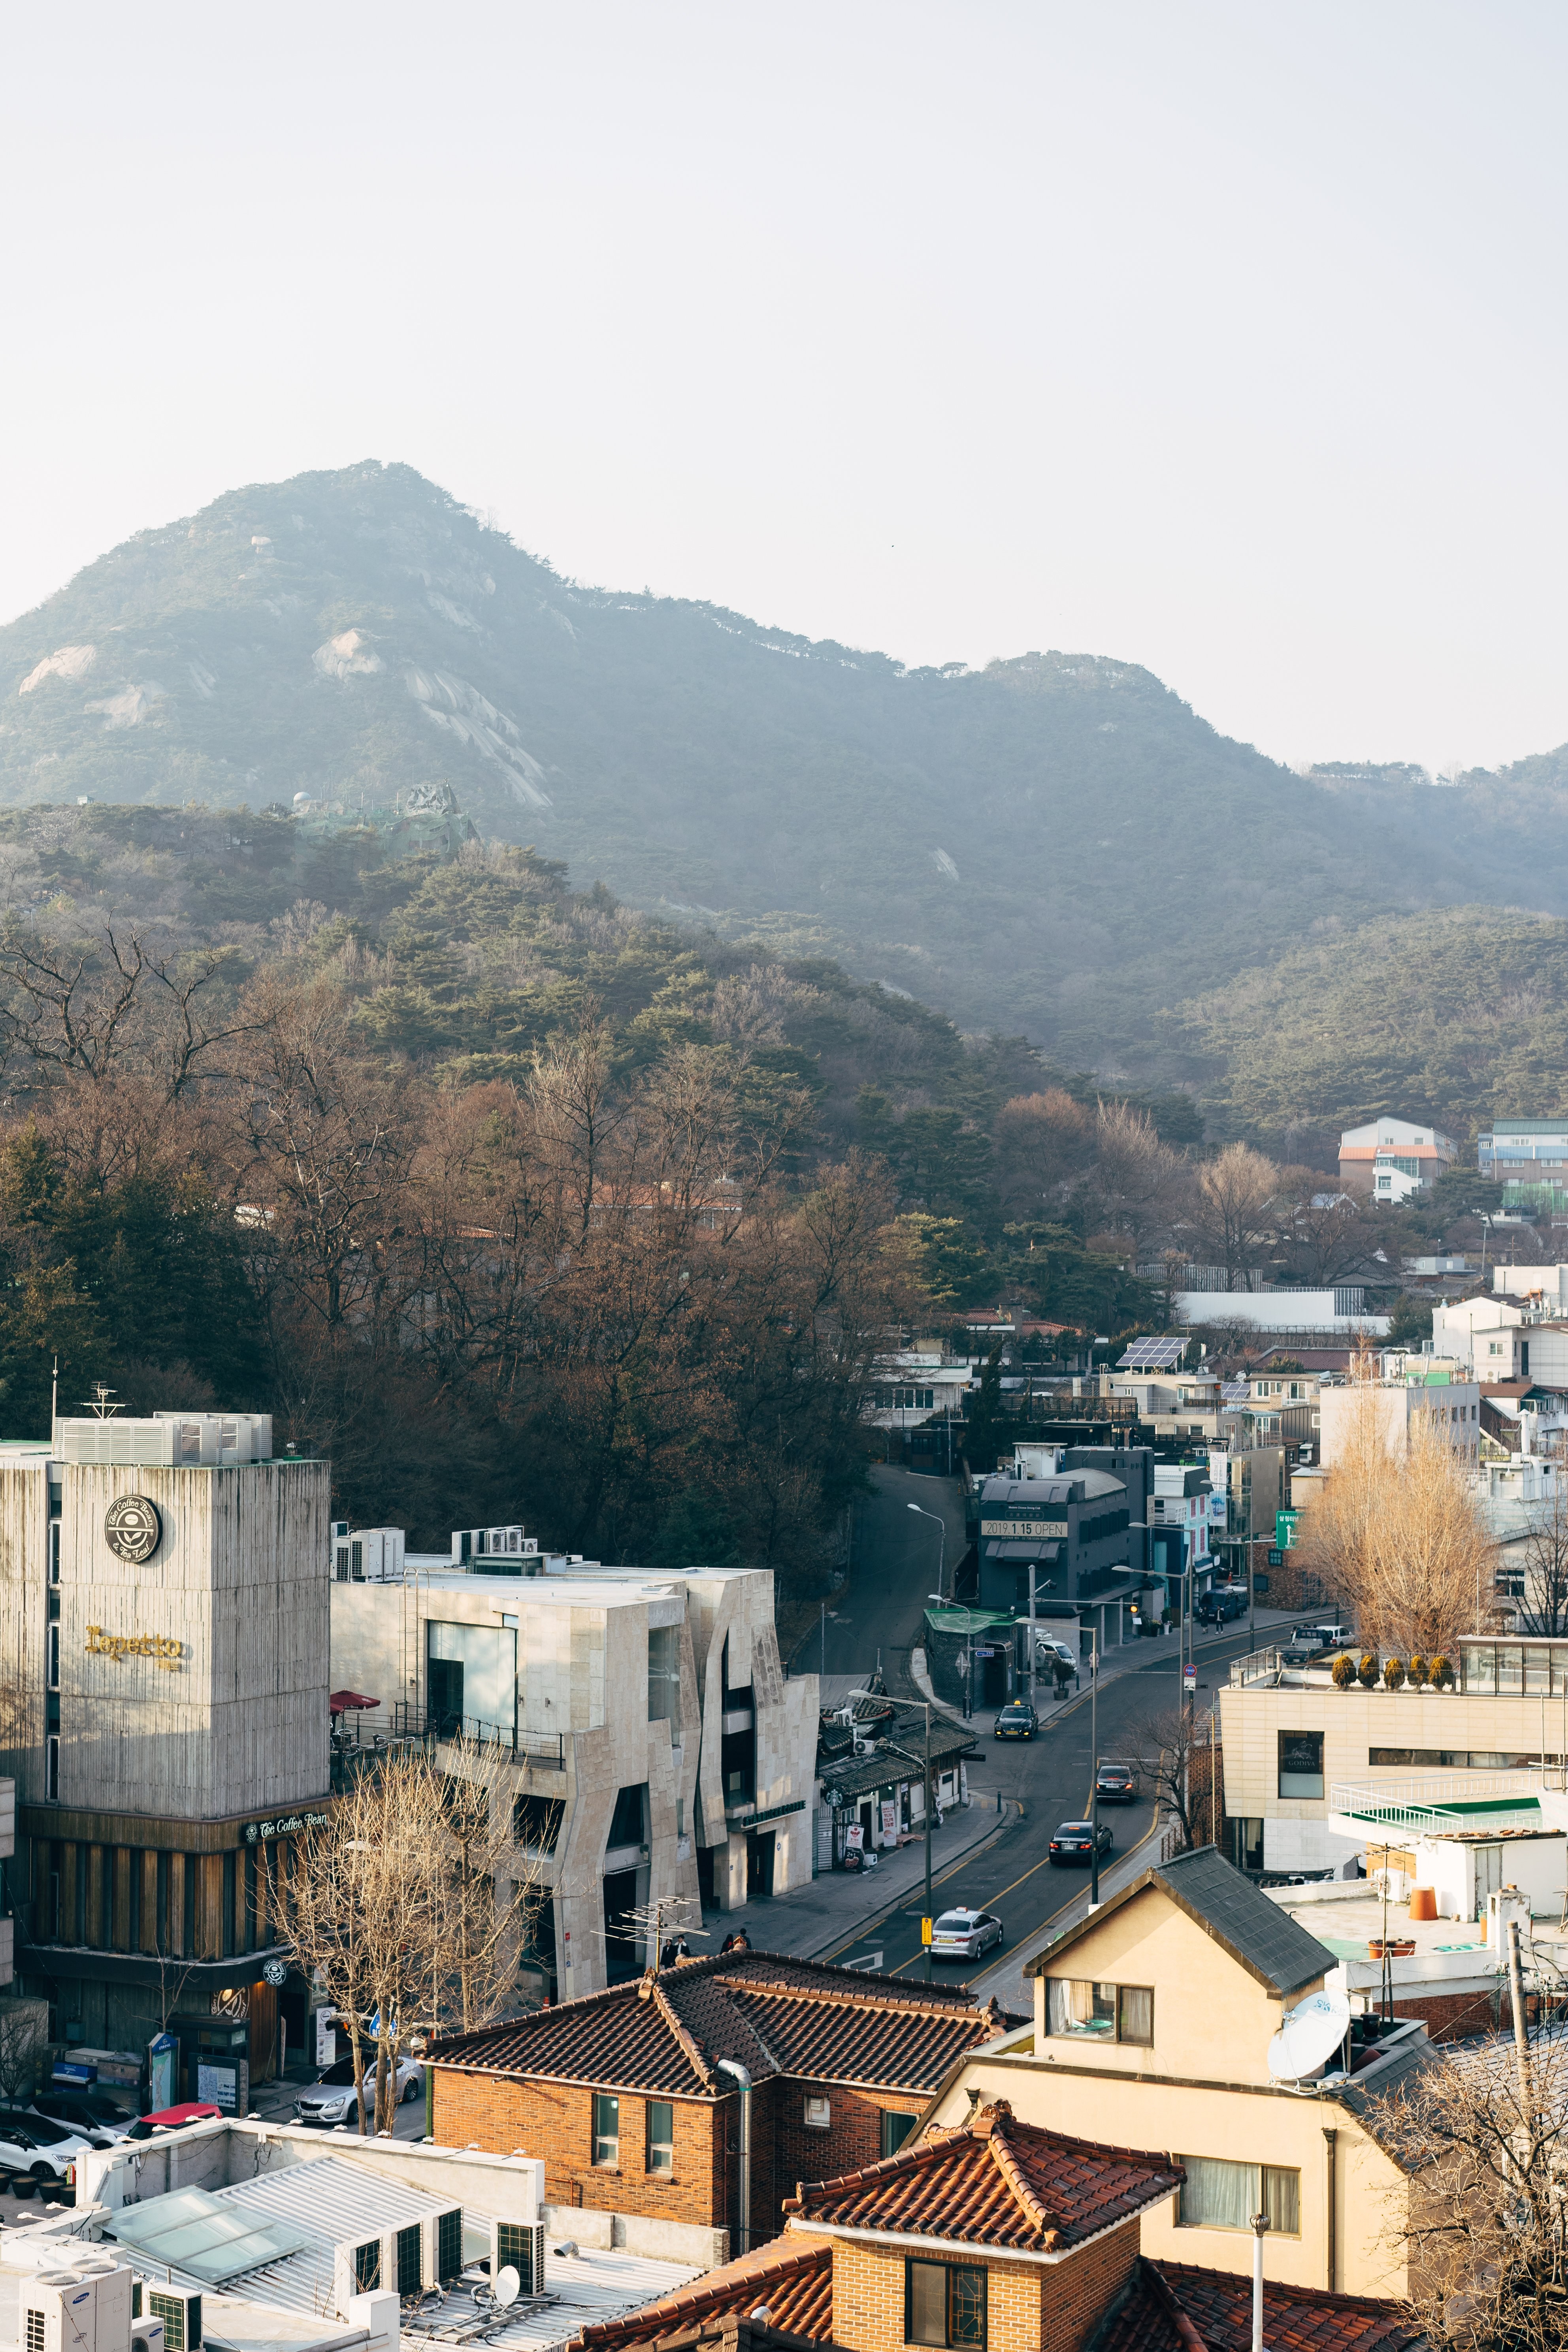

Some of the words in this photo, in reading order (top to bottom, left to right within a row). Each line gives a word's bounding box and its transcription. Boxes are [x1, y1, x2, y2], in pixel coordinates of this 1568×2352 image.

[108, 1510, 119, 1525] The
[117, 1498, 139, 1511] Coffee
[140, 1502, 153, 1528] Bean
[987, 1523, 1032, 1534] 2019.1.15
[1035, 1523, 1062, 1535] OPEN
[113, 1542, 119, 1551] &
[120, 1546, 131, 1559] Tea
[132, 1541, 150, 1558] Leaf
[85, 1625, 181, 1662] repetto
[260, 1822, 275, 1838] The
[277, 1817, 302, 1833] Coffee
[305, 1813, 328, 1826] Bean
[743, 1806, 783, 1826] STARBUCKS
[784, 1800, 806, 1815] COFFEE
